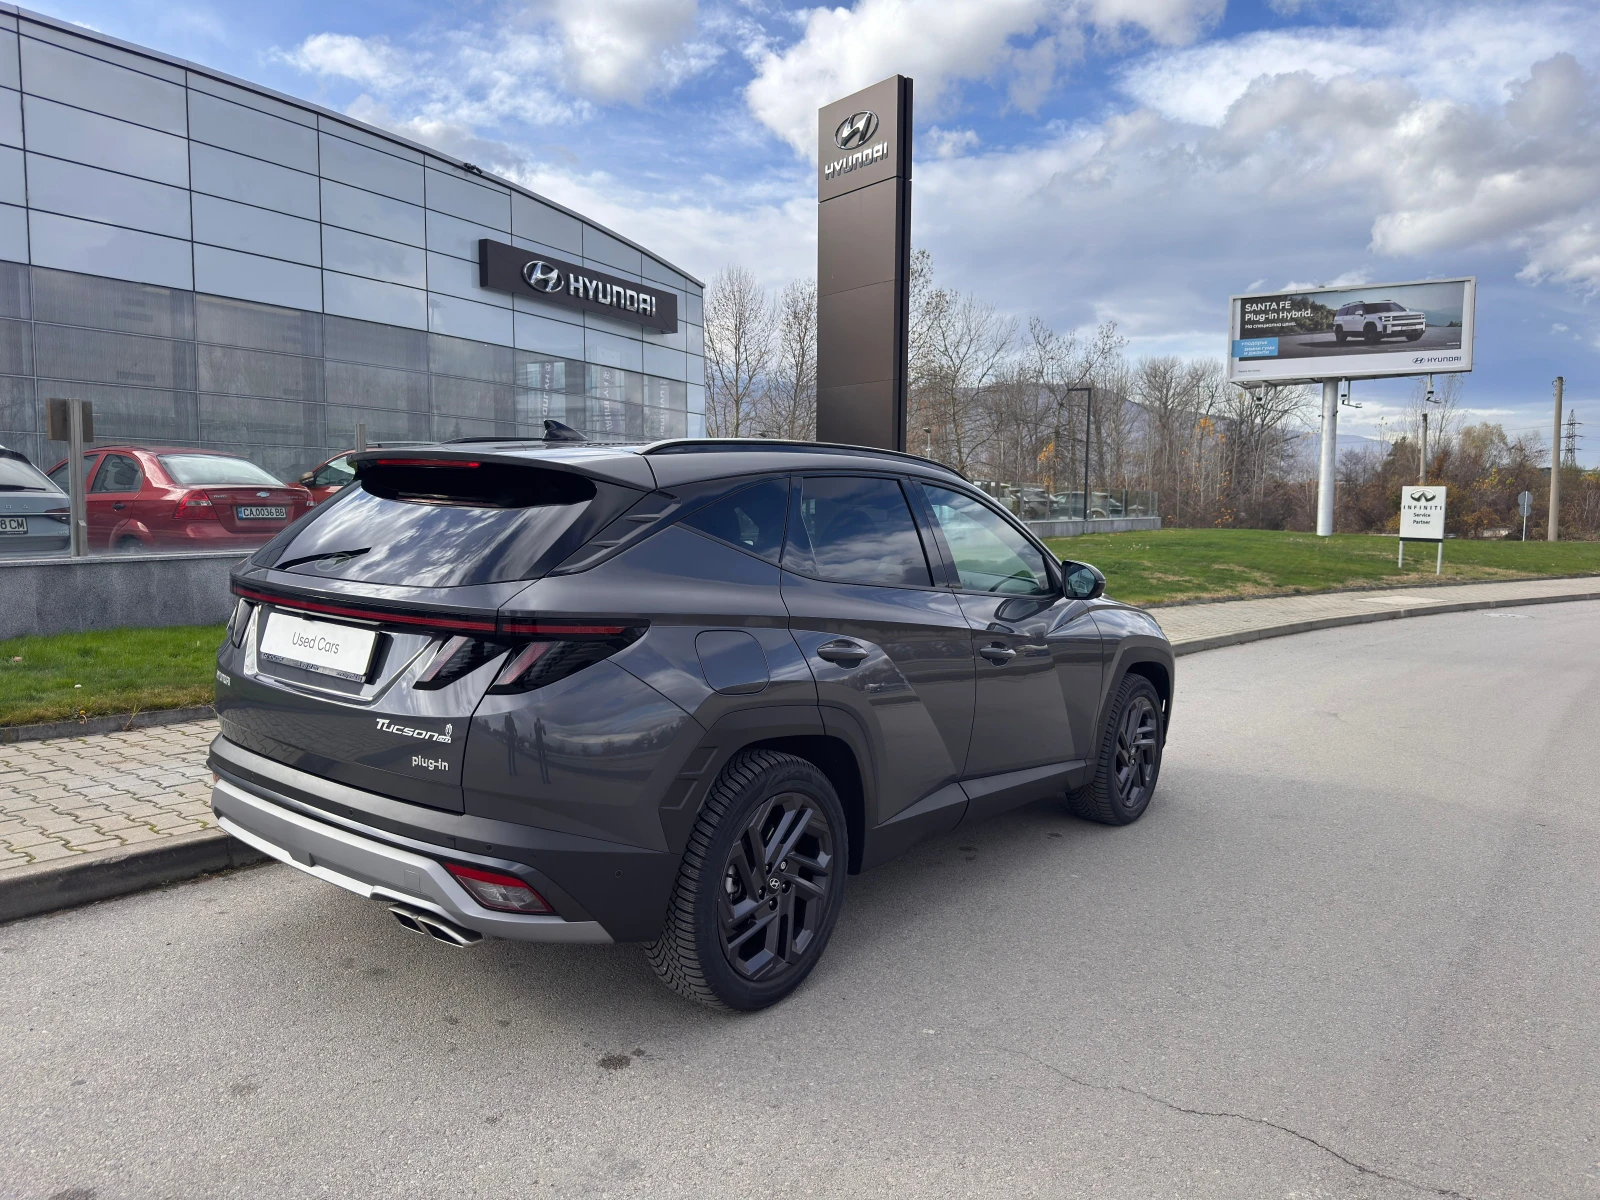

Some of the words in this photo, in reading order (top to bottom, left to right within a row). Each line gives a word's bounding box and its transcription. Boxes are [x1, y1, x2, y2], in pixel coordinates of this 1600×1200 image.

[825, 141, 888, 180] HYUNDAI
[569, 273, 656, 317] HYUNDAI
[1245, 302, 1278, 311] SANTA
[1279, 301, 1292, 309] FE
[1245, 311, 1278, 322] Plug-in
[1279, 308, 1314, 320] Hybrid.
[292, 632, 316, 649] Used
[317, 637, 340, 654] Cars
[412, 755, 449, 771] plug-in
